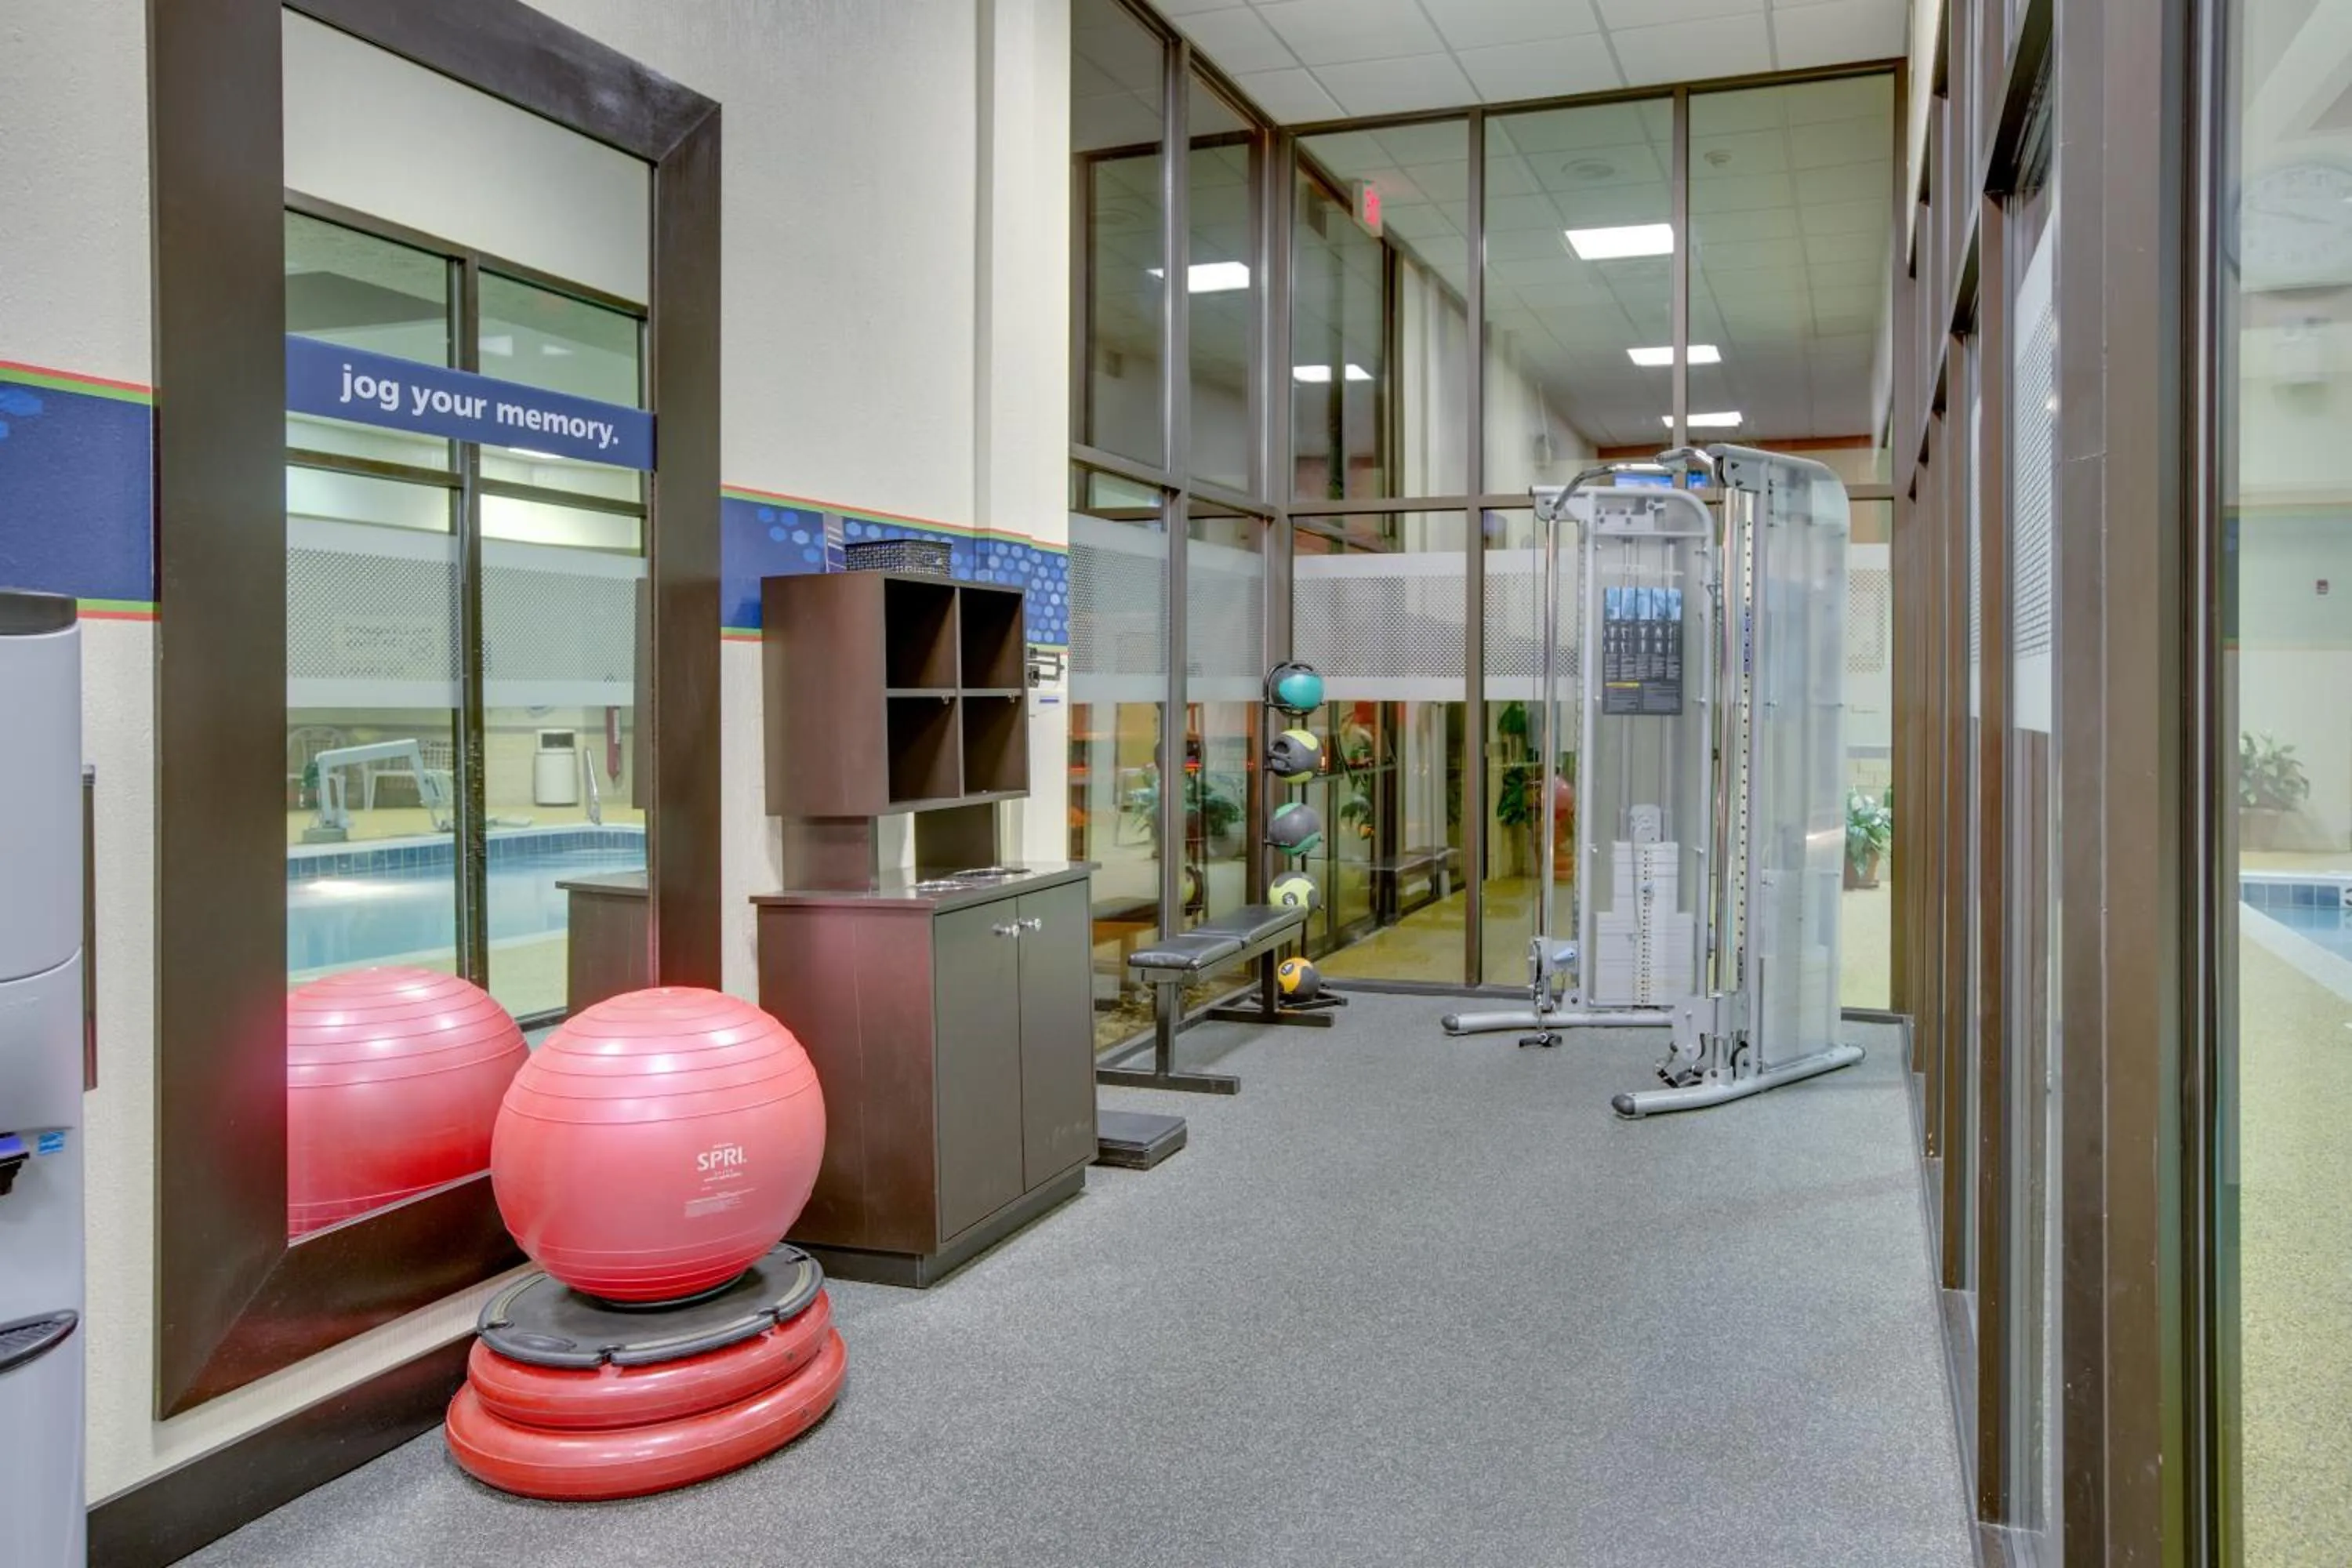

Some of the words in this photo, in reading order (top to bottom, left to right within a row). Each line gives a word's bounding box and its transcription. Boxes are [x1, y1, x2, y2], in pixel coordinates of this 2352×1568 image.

[339, 364, 399, 410] jog
[411, 384, 487, 421] your
[496, 401, 619, 449] memory.
